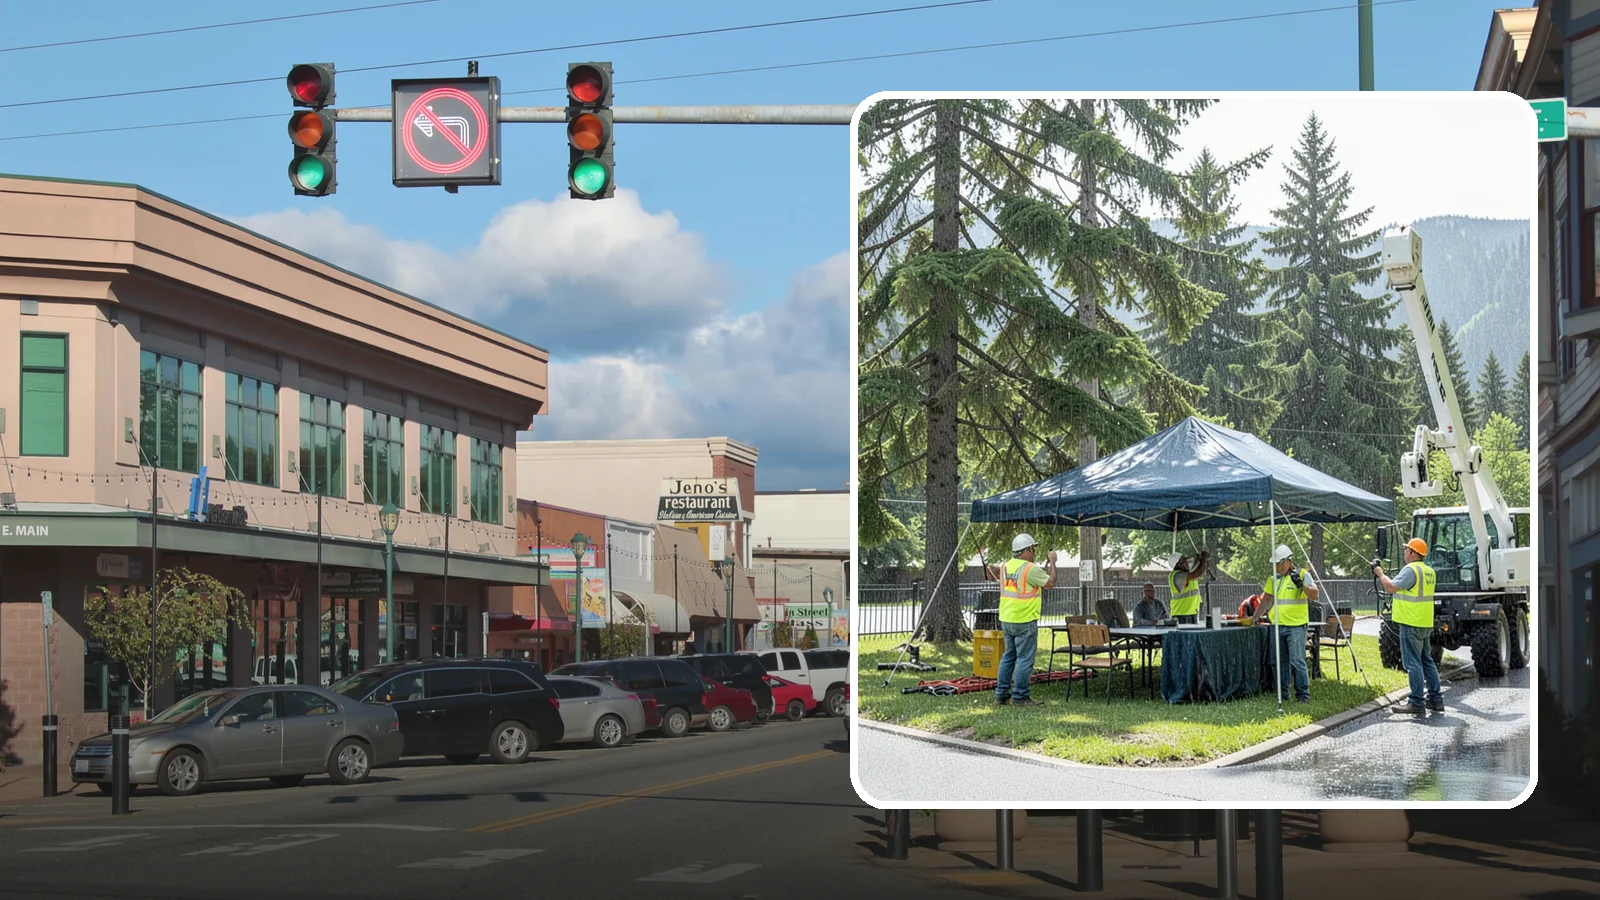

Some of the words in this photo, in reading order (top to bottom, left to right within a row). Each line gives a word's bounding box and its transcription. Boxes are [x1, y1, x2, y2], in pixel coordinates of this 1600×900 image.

[670, 480, 727, 494] Jeno's
[665, 496, 730, 509] restaurant
[659, 510, 682, 520] Italian
[686, 510, 714, 519] American
[715, 509, 737, 519] Cuisine
[2, 525, 13, 536] E.
[15, 525, 49, 536] MAIN
[797, 607, 828, 616] Street
